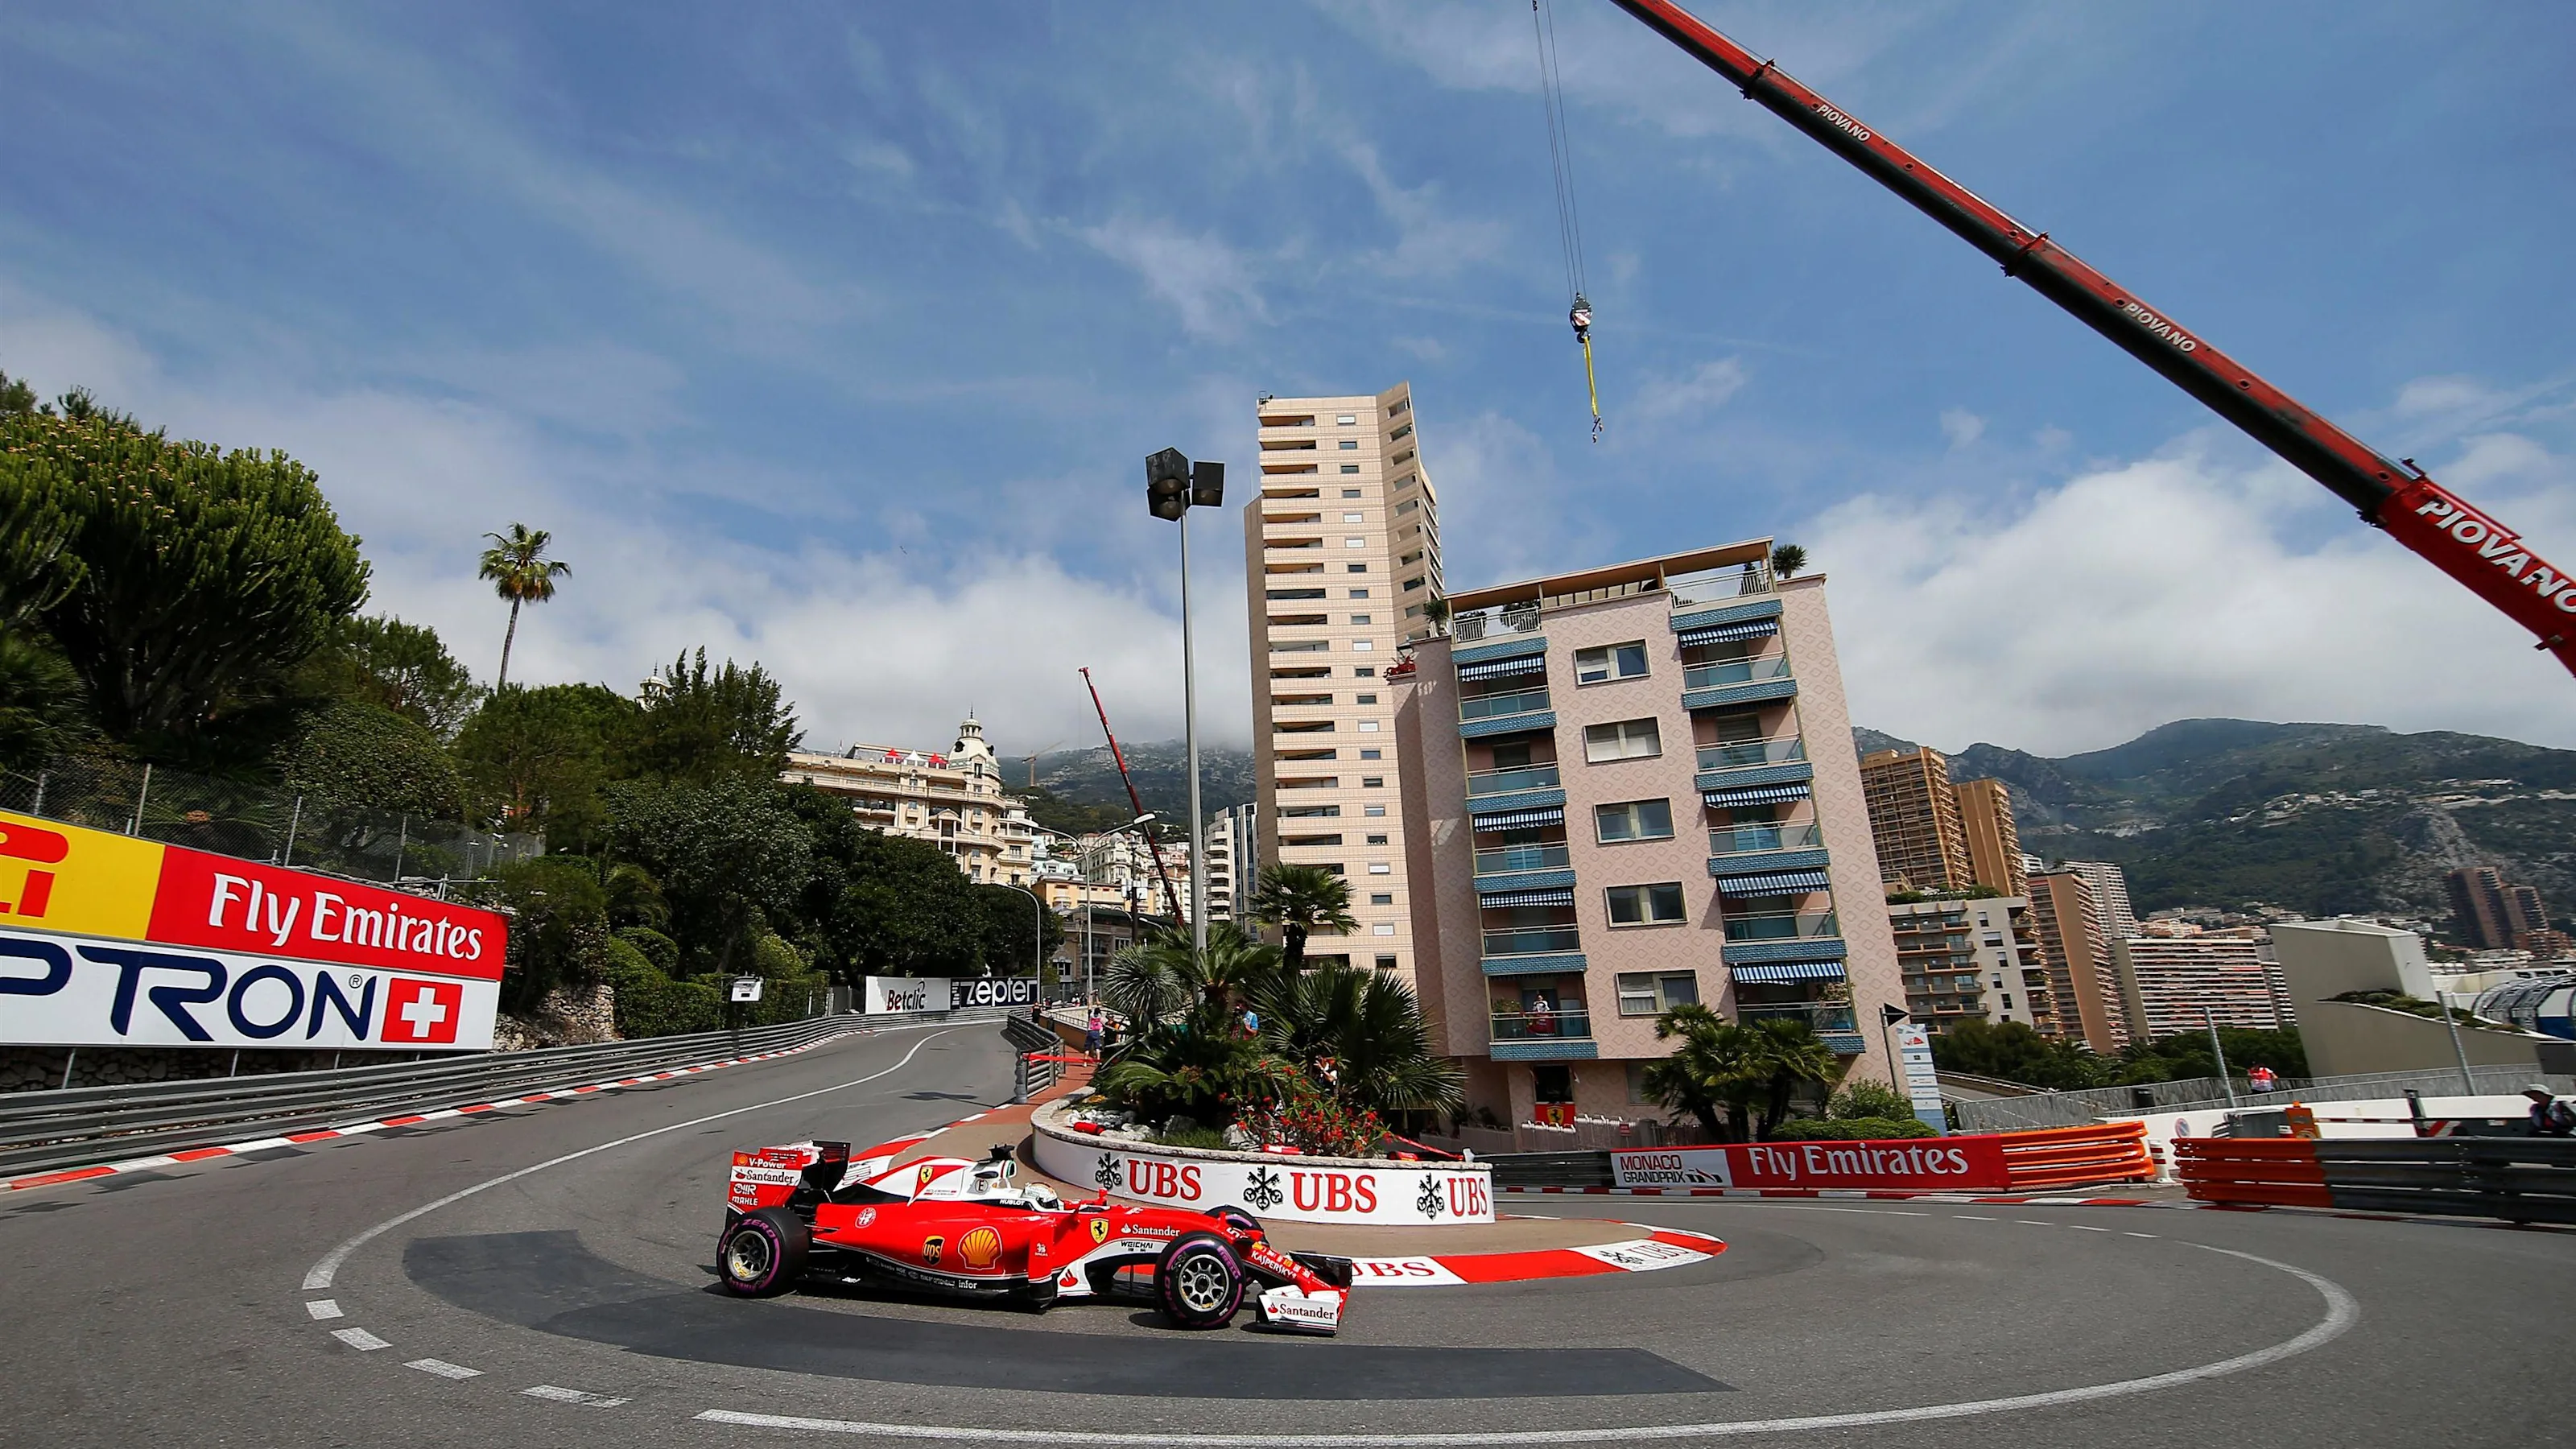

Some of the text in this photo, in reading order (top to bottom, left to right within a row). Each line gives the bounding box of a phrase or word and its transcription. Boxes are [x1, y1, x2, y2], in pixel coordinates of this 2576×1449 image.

[1817, 104, 1871, 142] PIOVANO
[2123, 303, 2196, 352] PIOVANO
[208, 872, 482, 960] Fly Emirates
[886, 989, 926, 1010] Betclic
[749, 1157, 786, 1170] V-Power
[1620, 1154, 1682, 1170] MONACO
[1747, 1141, 1969, 1181] Fly Emirates
[746, 1169, 795, 1184] Santander
[1127, 1159, 1202, 1201] UBS
[1290, 1172, 1377, 1213] UBS
[1447, 1177, 1488, 1217] UBS
[999, 1199, 1026, 1207] HUBLOT
[1132, 1224, 1181, 1237] Santander
[923, 1243, 941, 1261] ups
[1121, 1241, 1154, 1249] WEICHAI
[1625, 1243, 1690, 1260] UBS
[958, 1279, 978, 1289] infor
[1279, 1302, 1335, 1319] Santander
